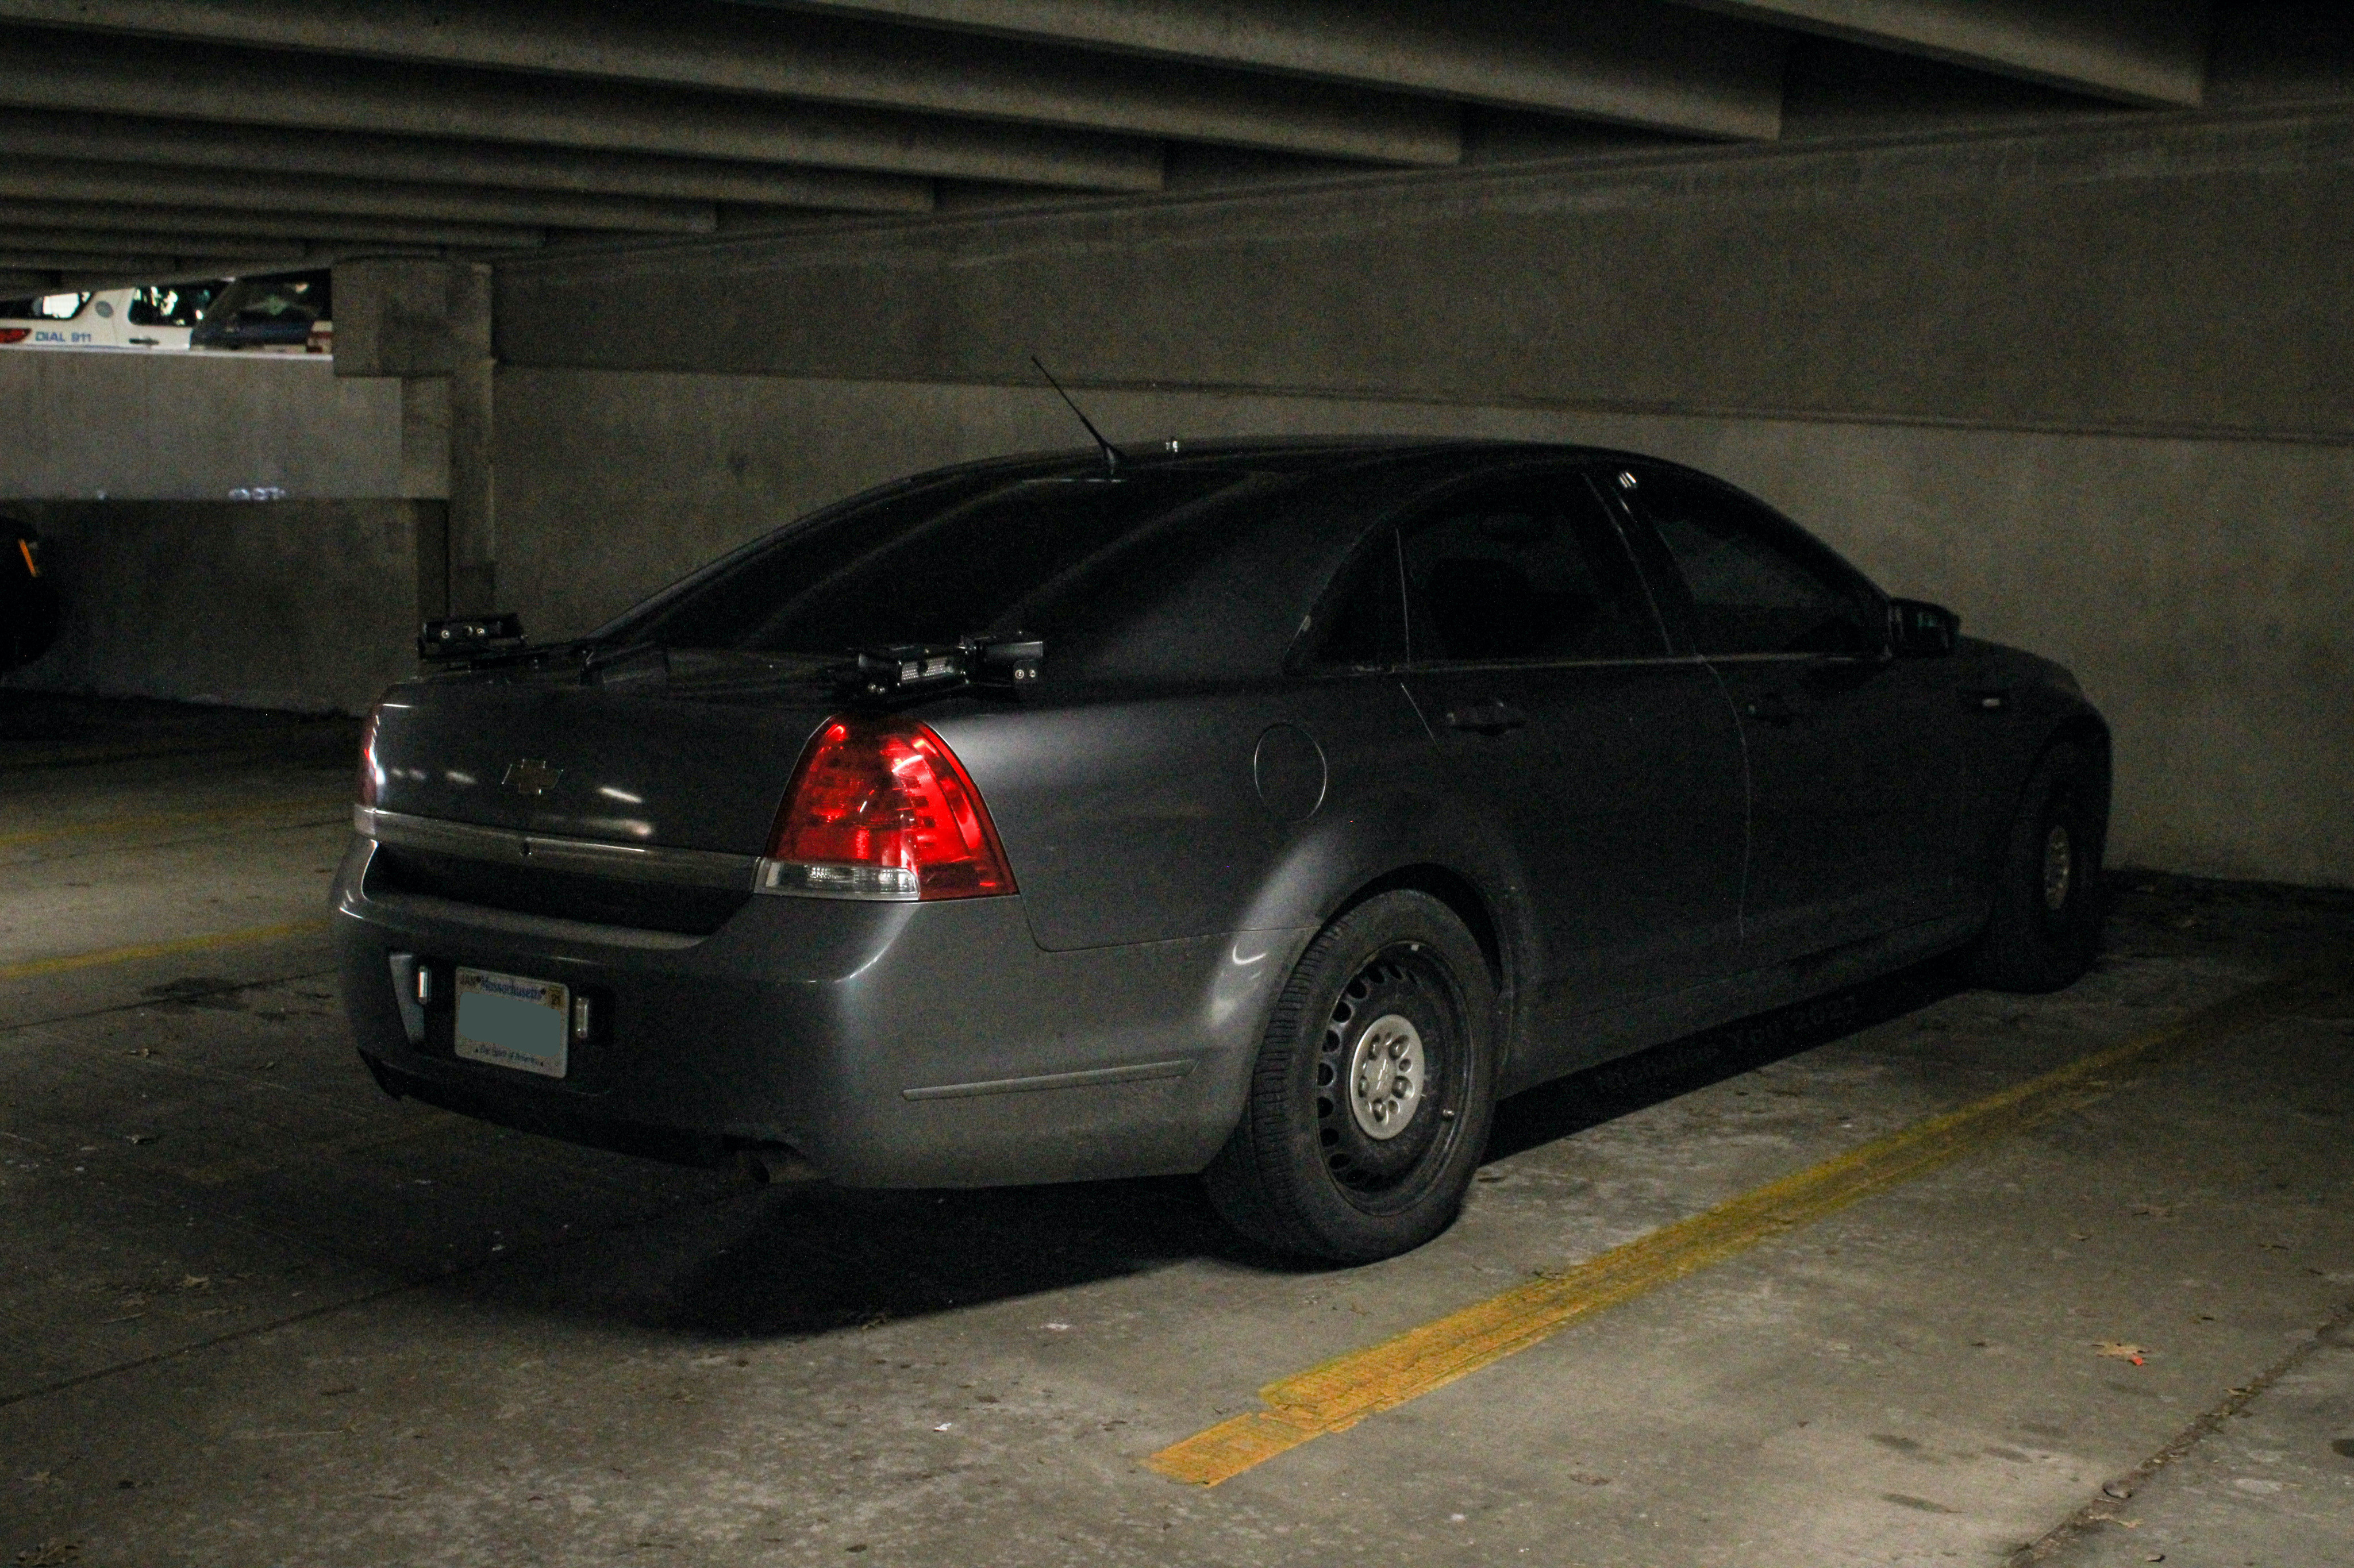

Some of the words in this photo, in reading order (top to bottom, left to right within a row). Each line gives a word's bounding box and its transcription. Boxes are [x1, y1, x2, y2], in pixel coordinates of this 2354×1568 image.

[35, 331, 65, 342] DIAL
[71, 332, 91, 342] 911
[480, 977, 542, 1000] Massachusetts
